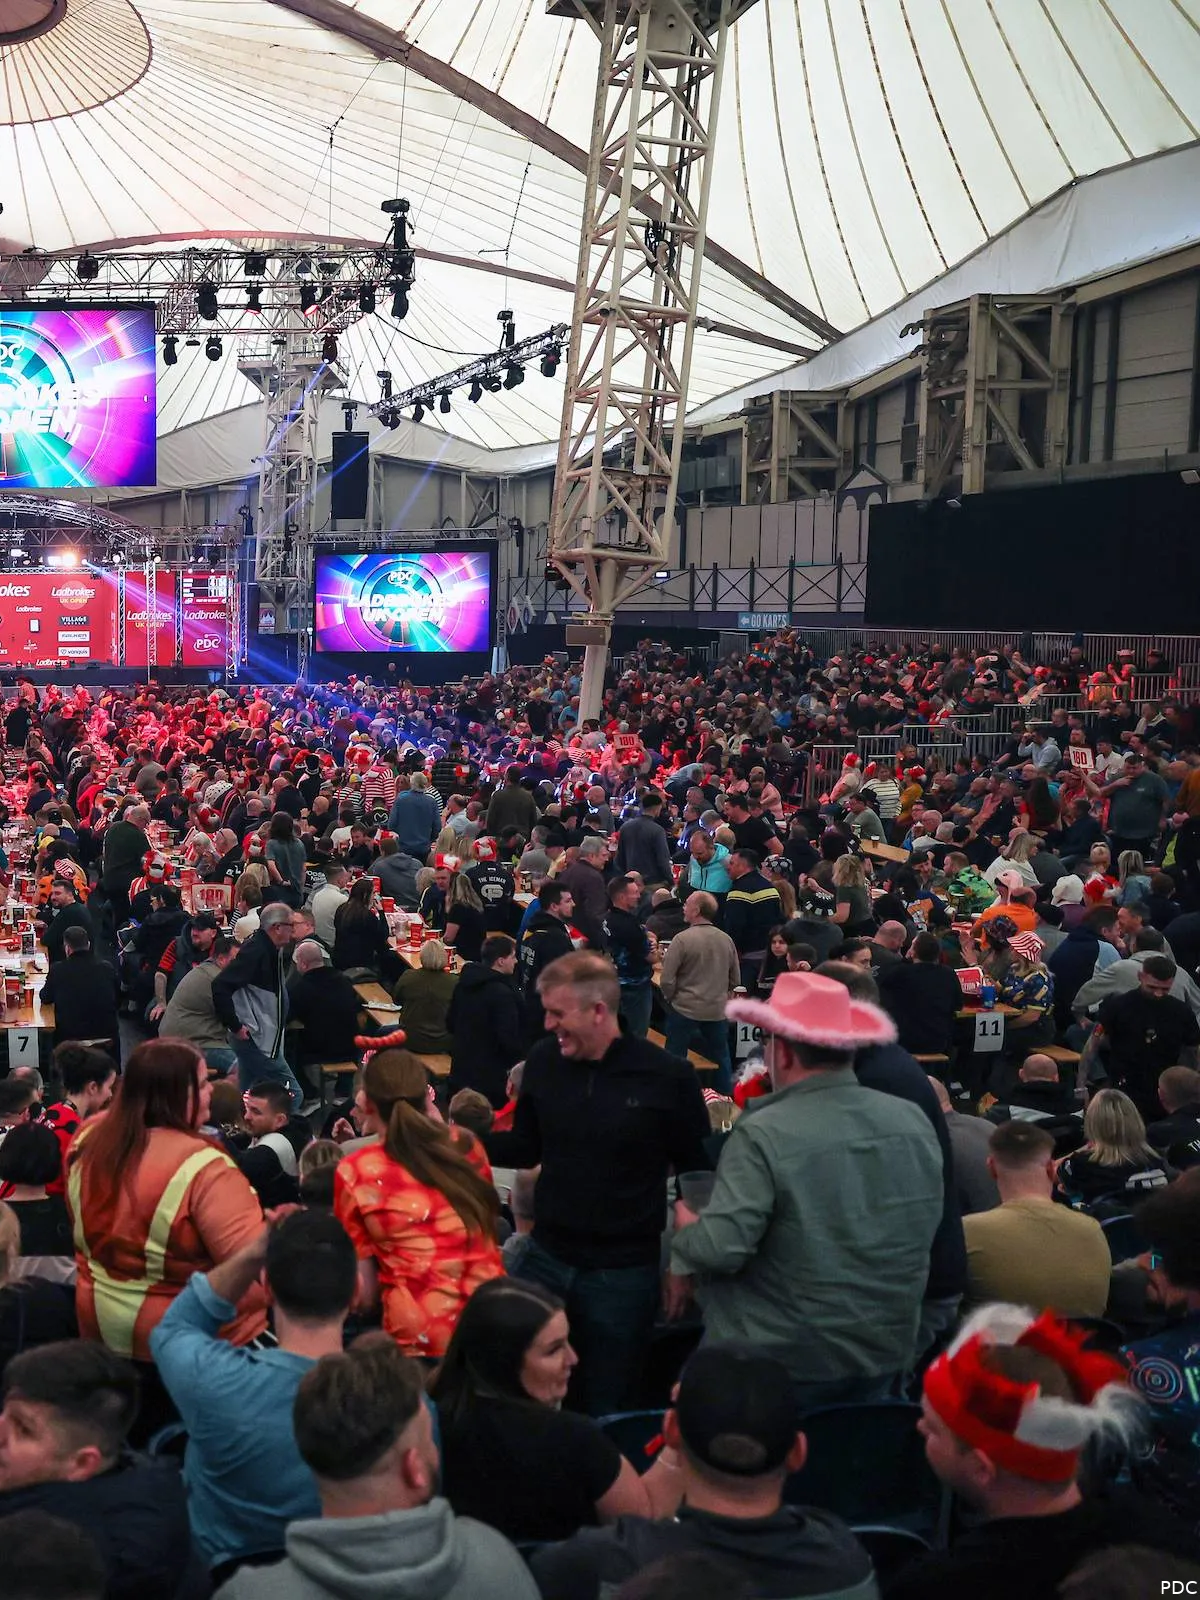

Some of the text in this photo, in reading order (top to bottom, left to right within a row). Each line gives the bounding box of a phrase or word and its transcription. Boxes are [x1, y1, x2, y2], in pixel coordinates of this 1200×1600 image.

[51, 587, 96, 596] Ladbrokes
[347, 593, 455, 607] LADBK
[184, 610, 227, 620] Ladbroke
[388, 608, 443, 621] OEN
[751, 614, 787, 627] GO KARTS
[195, 637, 220, 650] PDC
[1072, 751, 1087, 765] 180
[978, 1020, 1001, 1036] 11
[17, 1036, 29, 1052] 7
